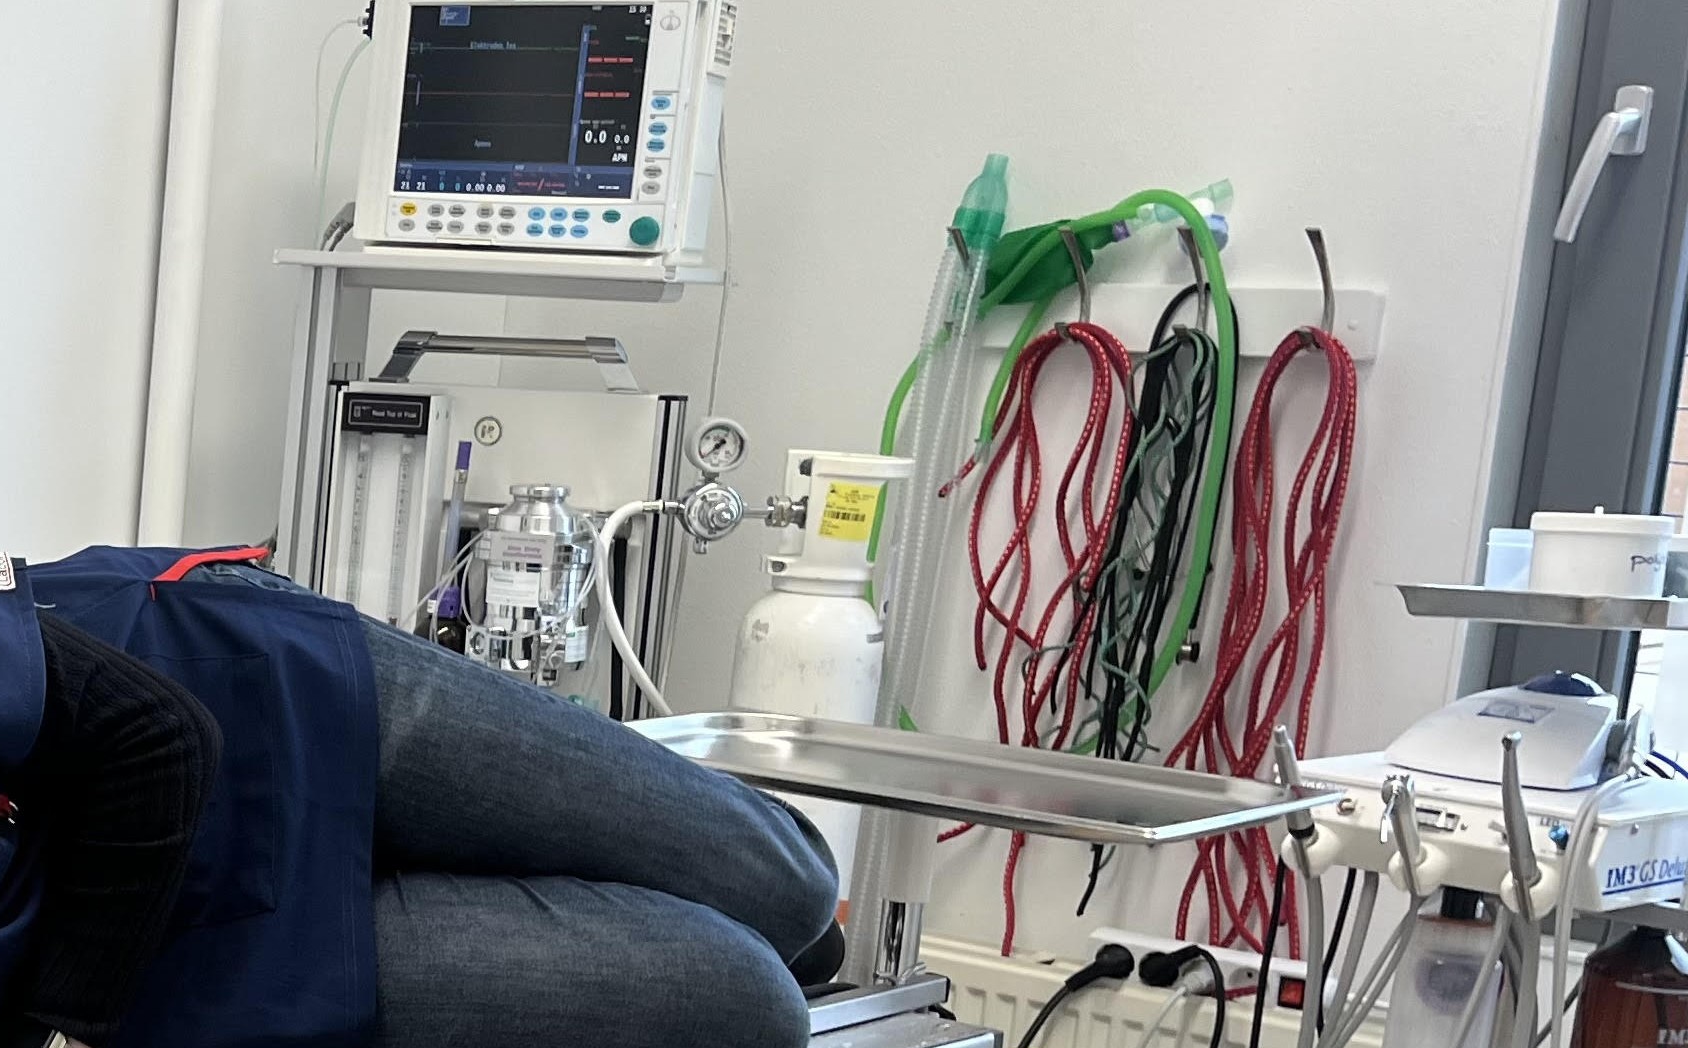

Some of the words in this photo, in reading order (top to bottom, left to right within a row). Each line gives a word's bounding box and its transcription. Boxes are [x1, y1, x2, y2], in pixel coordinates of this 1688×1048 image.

[585, 130, 607, 143] 0.0
[614, 134, 630, 144] 0.0
[1606, 865, 1636, 888] IM3
